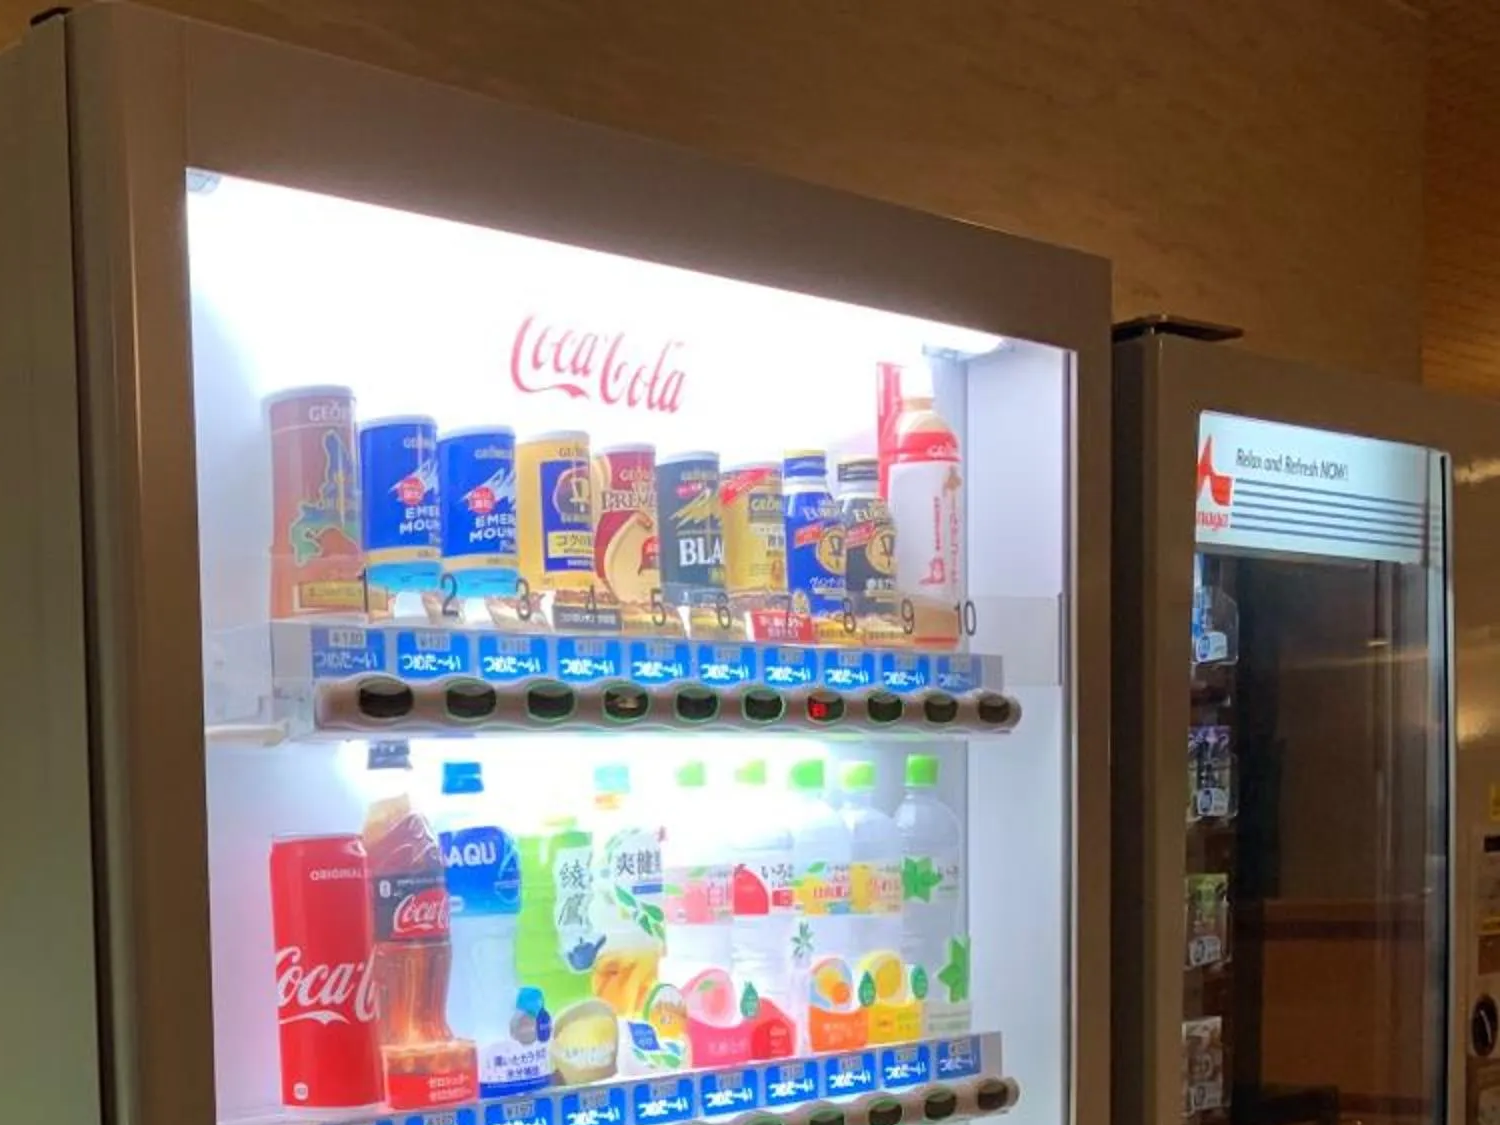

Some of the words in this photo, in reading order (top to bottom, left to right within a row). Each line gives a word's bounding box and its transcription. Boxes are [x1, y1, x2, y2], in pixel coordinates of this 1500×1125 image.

[1236, 448, 1262, 468] Relax
[1263, 453, 1283, 471] and
[1285, 455, 1318, 477] Refresh
[441, 574, 459, 617] 2
[651, 588, 666, 626] 5
[716, 592, 731, 630] 6
[901, 598, 915, 635] 9
[955, 600, 977, 636] 10
